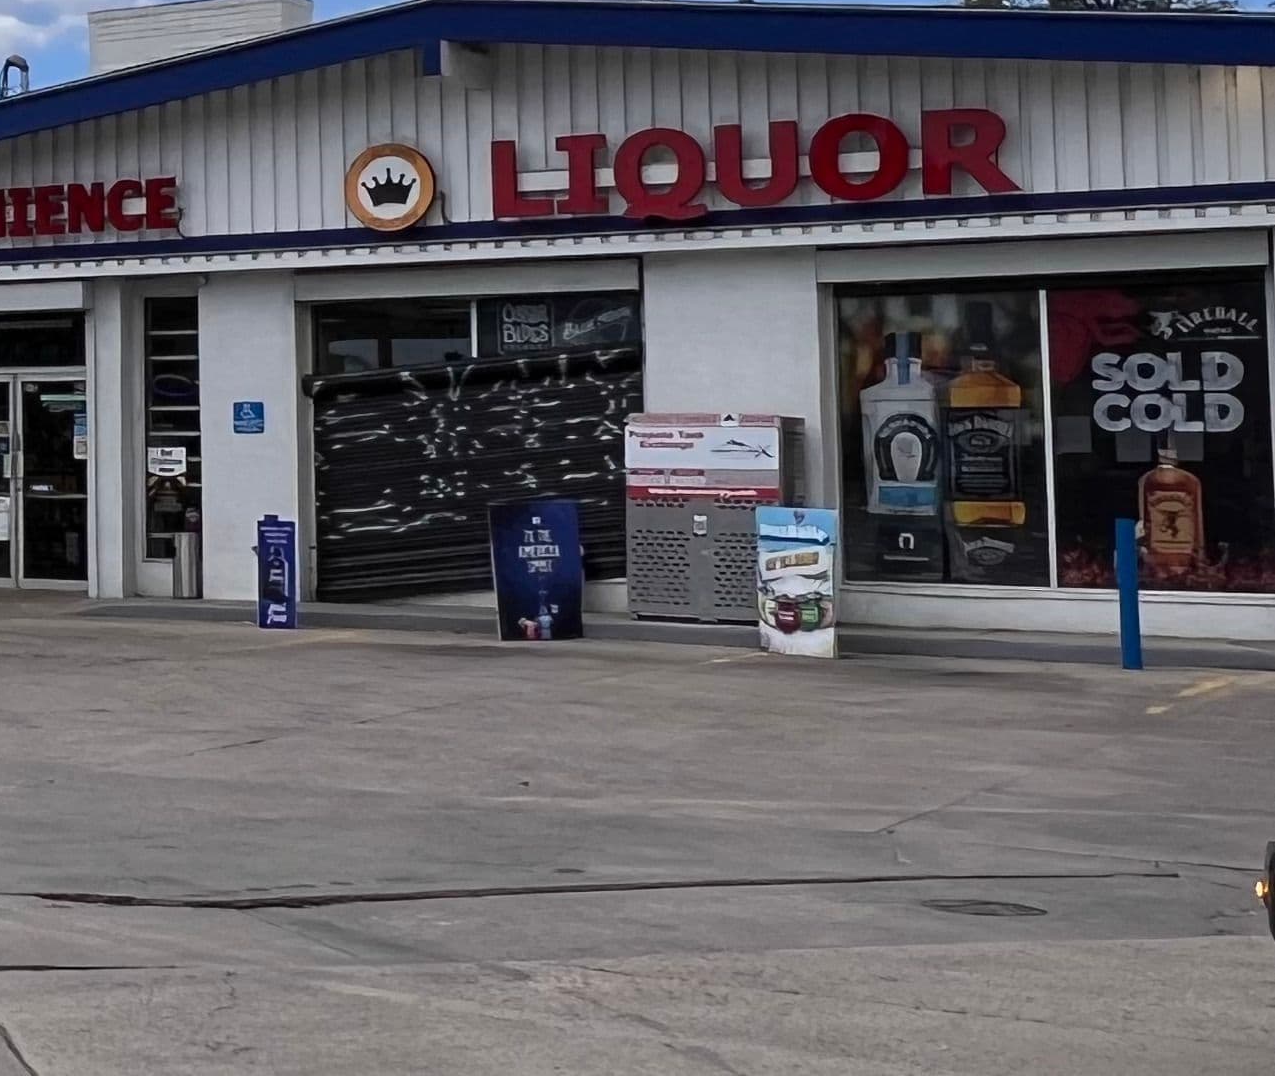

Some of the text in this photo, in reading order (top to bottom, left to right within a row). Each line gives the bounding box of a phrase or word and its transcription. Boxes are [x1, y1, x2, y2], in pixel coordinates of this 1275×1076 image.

[491, 107, 1025, 221] LIQUOR
[1091, 351, 1245, 392] SOLD
[1093, 392, 1245, 433] COLD
